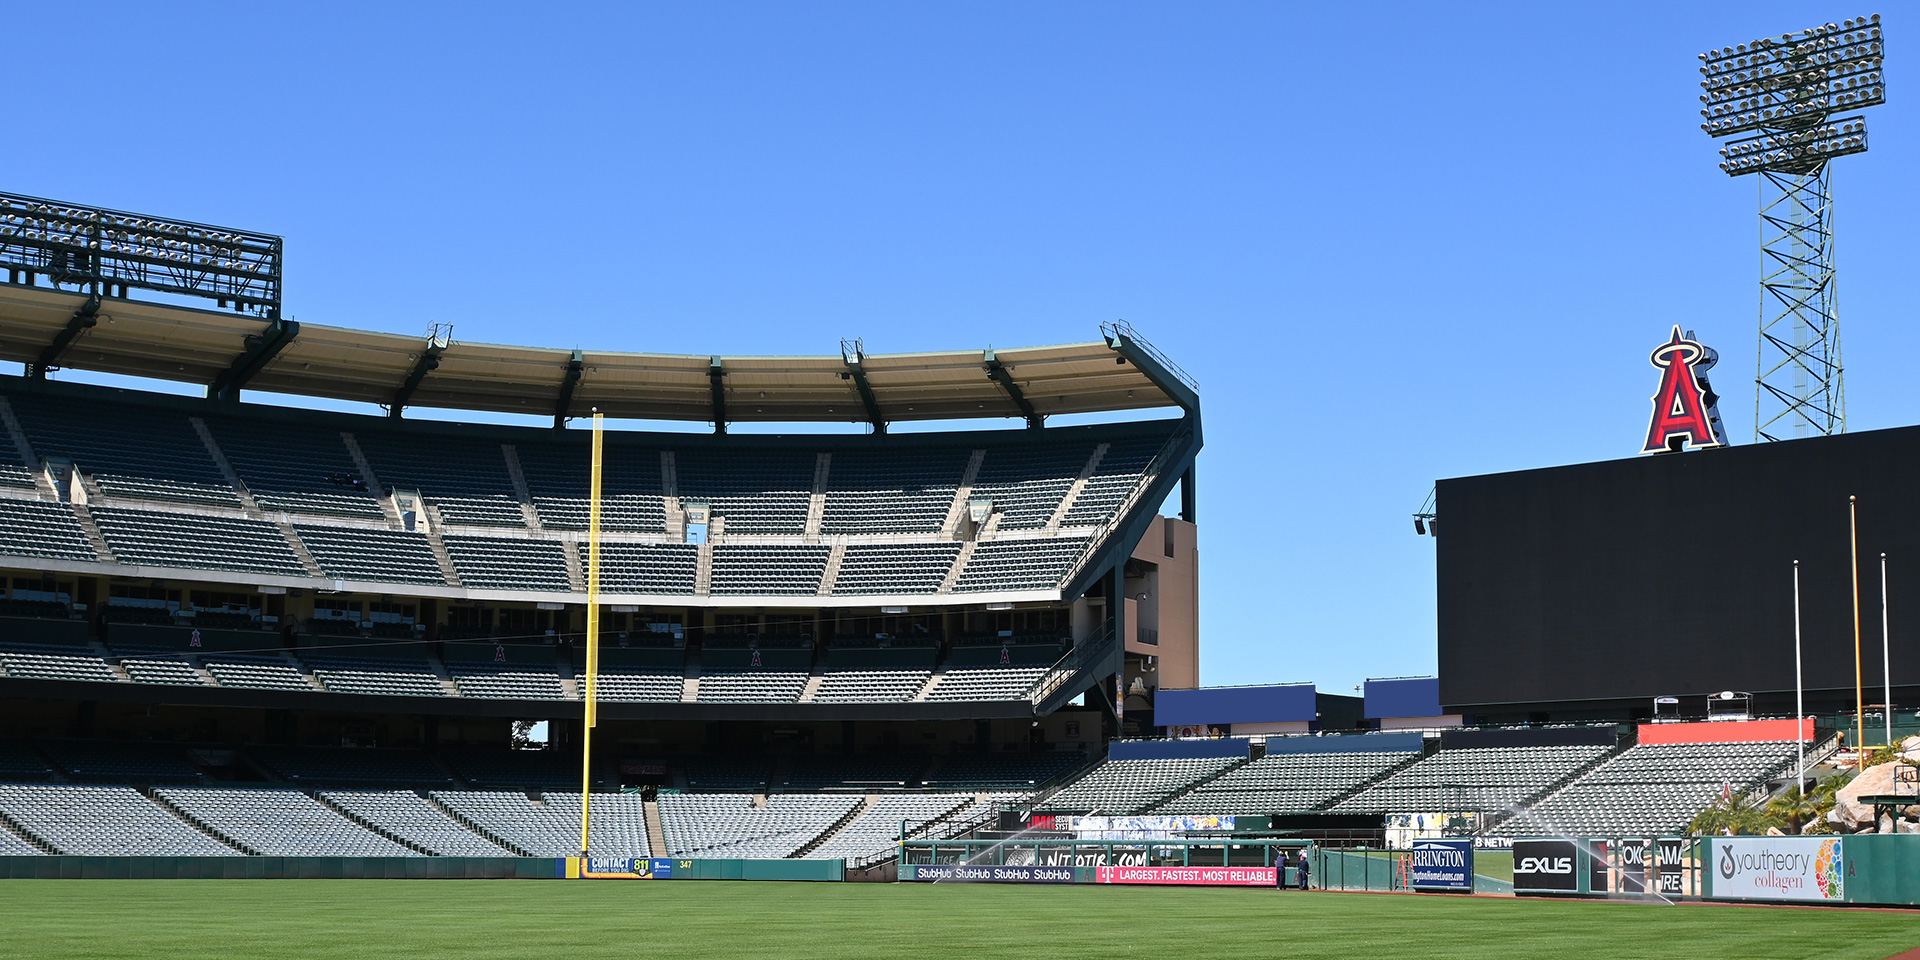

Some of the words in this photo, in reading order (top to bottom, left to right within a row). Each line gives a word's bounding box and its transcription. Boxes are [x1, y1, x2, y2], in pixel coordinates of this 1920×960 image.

[1639, 324, 1720, 455] A
[1055, 823, 1069, 831] SYST
[1485, 838, 1514, 848] NETW
[592, 858, 629, 868] CONTACT
[634, 860, 649, 870] 811
[1413, 850, 1465, 867] RRINGTON
[1513, 857, 1572, 874] LEXUS
[1736, 849, 1810, 875] youtheory
[918, 866, 951, 878] StubHub
[956, 867, 990, 879] StubHub
[994, 867, 1029, 880] StubHub
[1034, 867, 1070, 880] StubHub
[1120, 870, 1160, 880] LARGEST.
[1162, 871, 1200, 881] FASTEST.
[1203, 871, 1228, 881] MOST
[1231, 871, 1276, 881] RELIABLE.
[1755, 871, 1804, 894] collagen
